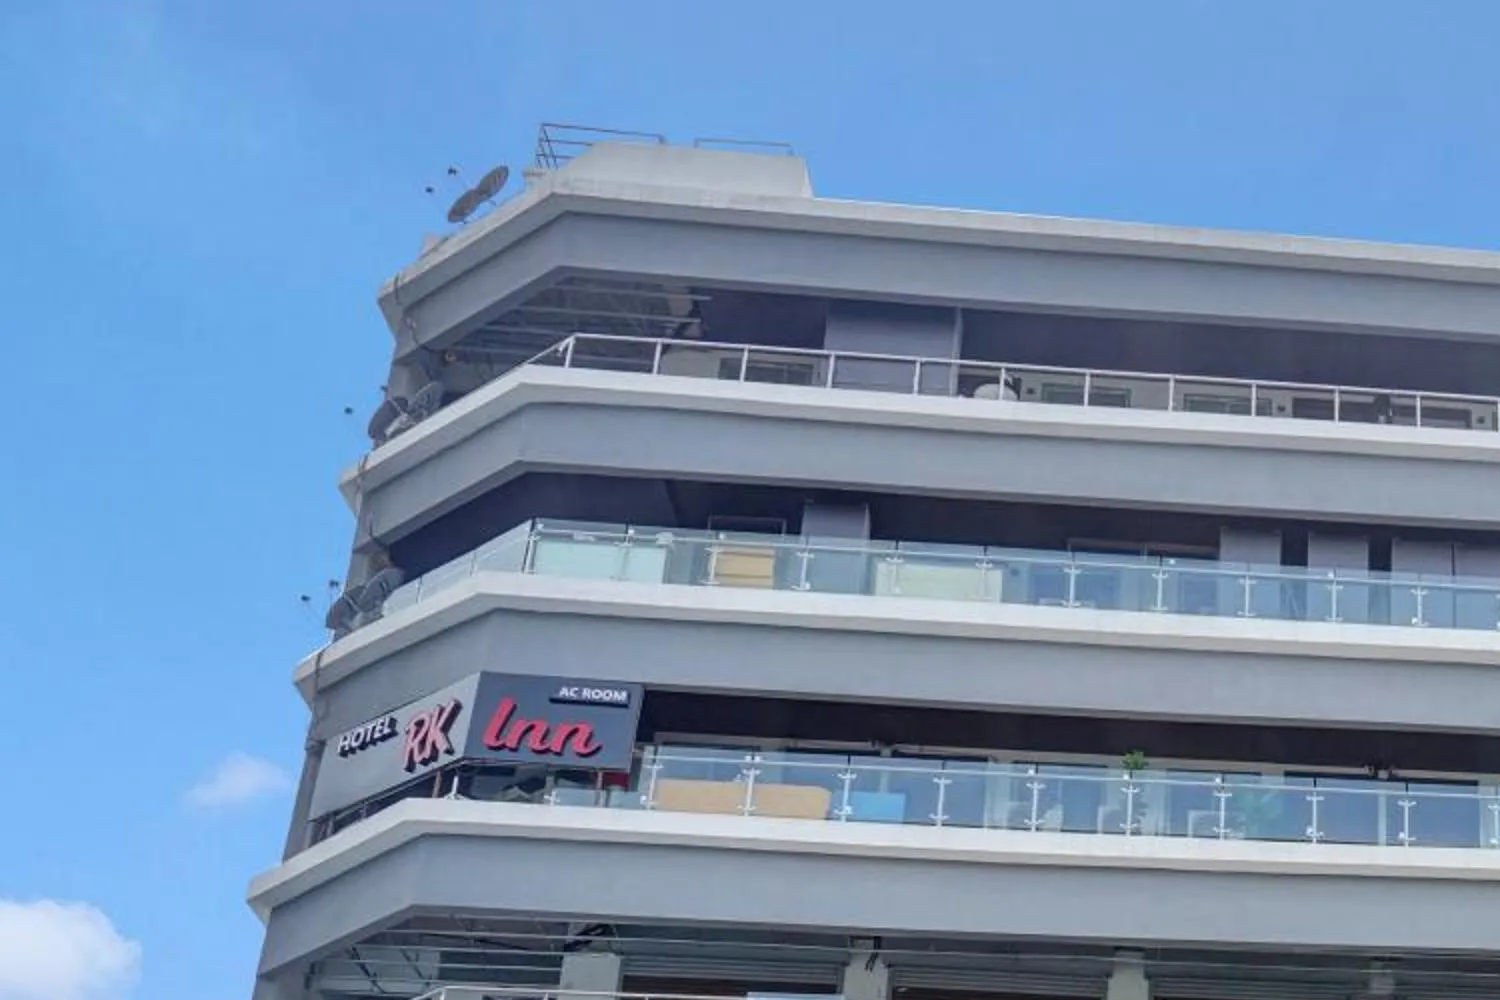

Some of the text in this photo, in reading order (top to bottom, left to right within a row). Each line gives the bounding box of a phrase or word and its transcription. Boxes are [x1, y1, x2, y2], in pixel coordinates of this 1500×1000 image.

[560, 686, 628, 702] AC ROOM
[338, 699, 461, 770] HOTEL RK
[482, 697, 602, 756] Inn
